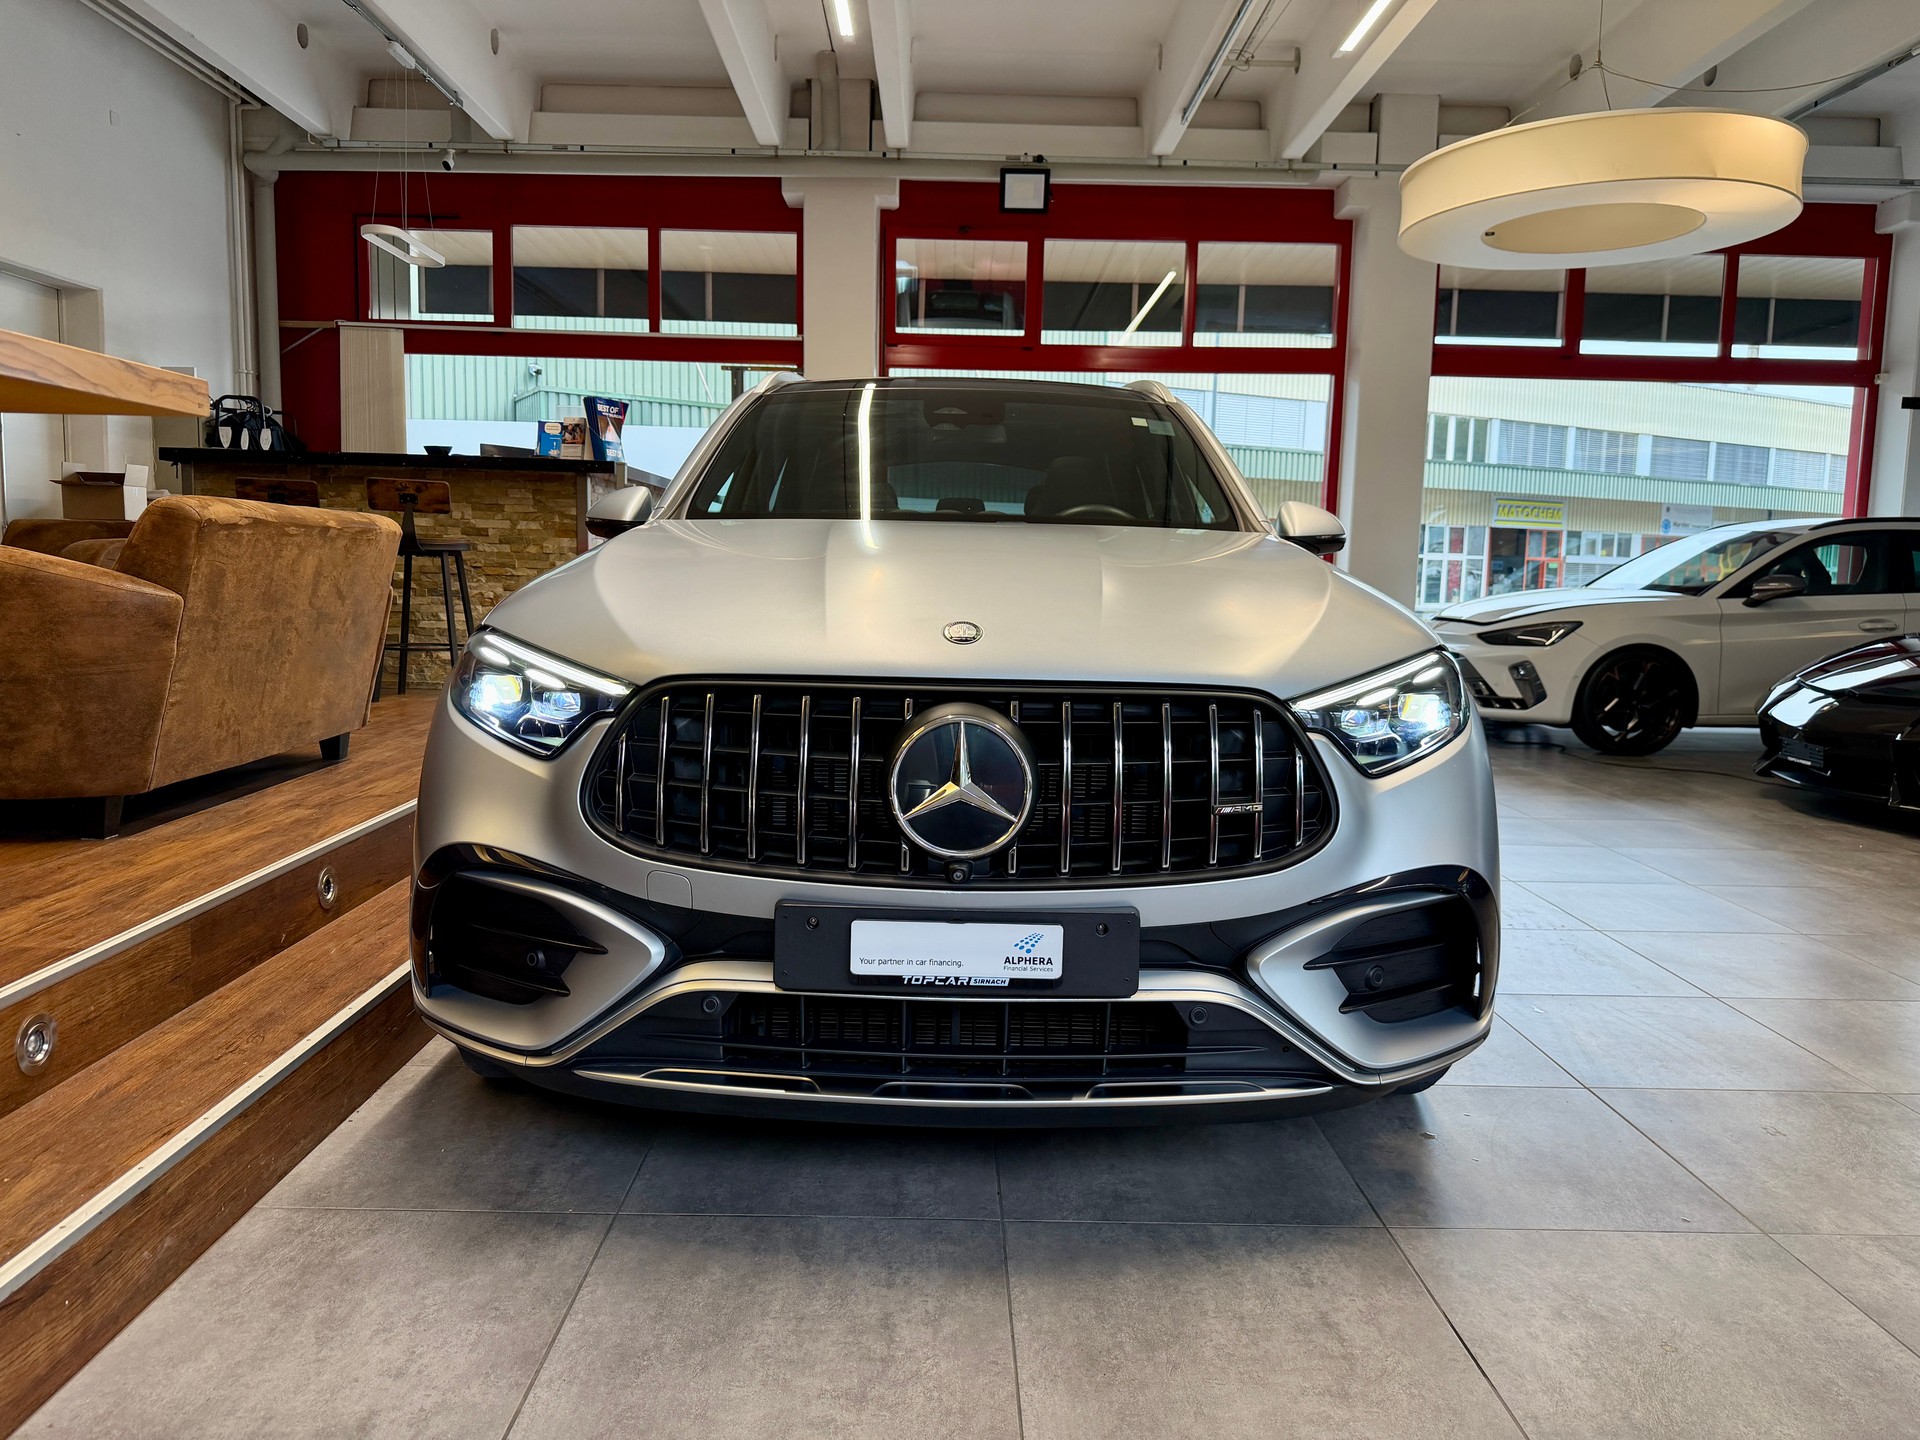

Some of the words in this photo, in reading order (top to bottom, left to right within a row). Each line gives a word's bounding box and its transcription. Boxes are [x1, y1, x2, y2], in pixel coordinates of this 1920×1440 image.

[597, 404, 610, 413] BEST
[1497, 505, 1563, 520] MATOCHEM
[859, 957, 876, 965] Your
[928, 959, 964, 968] financing.
[1003, 956, 1054, 966] ALPHERA
[902, 976, 969, 985] TOPCAR
